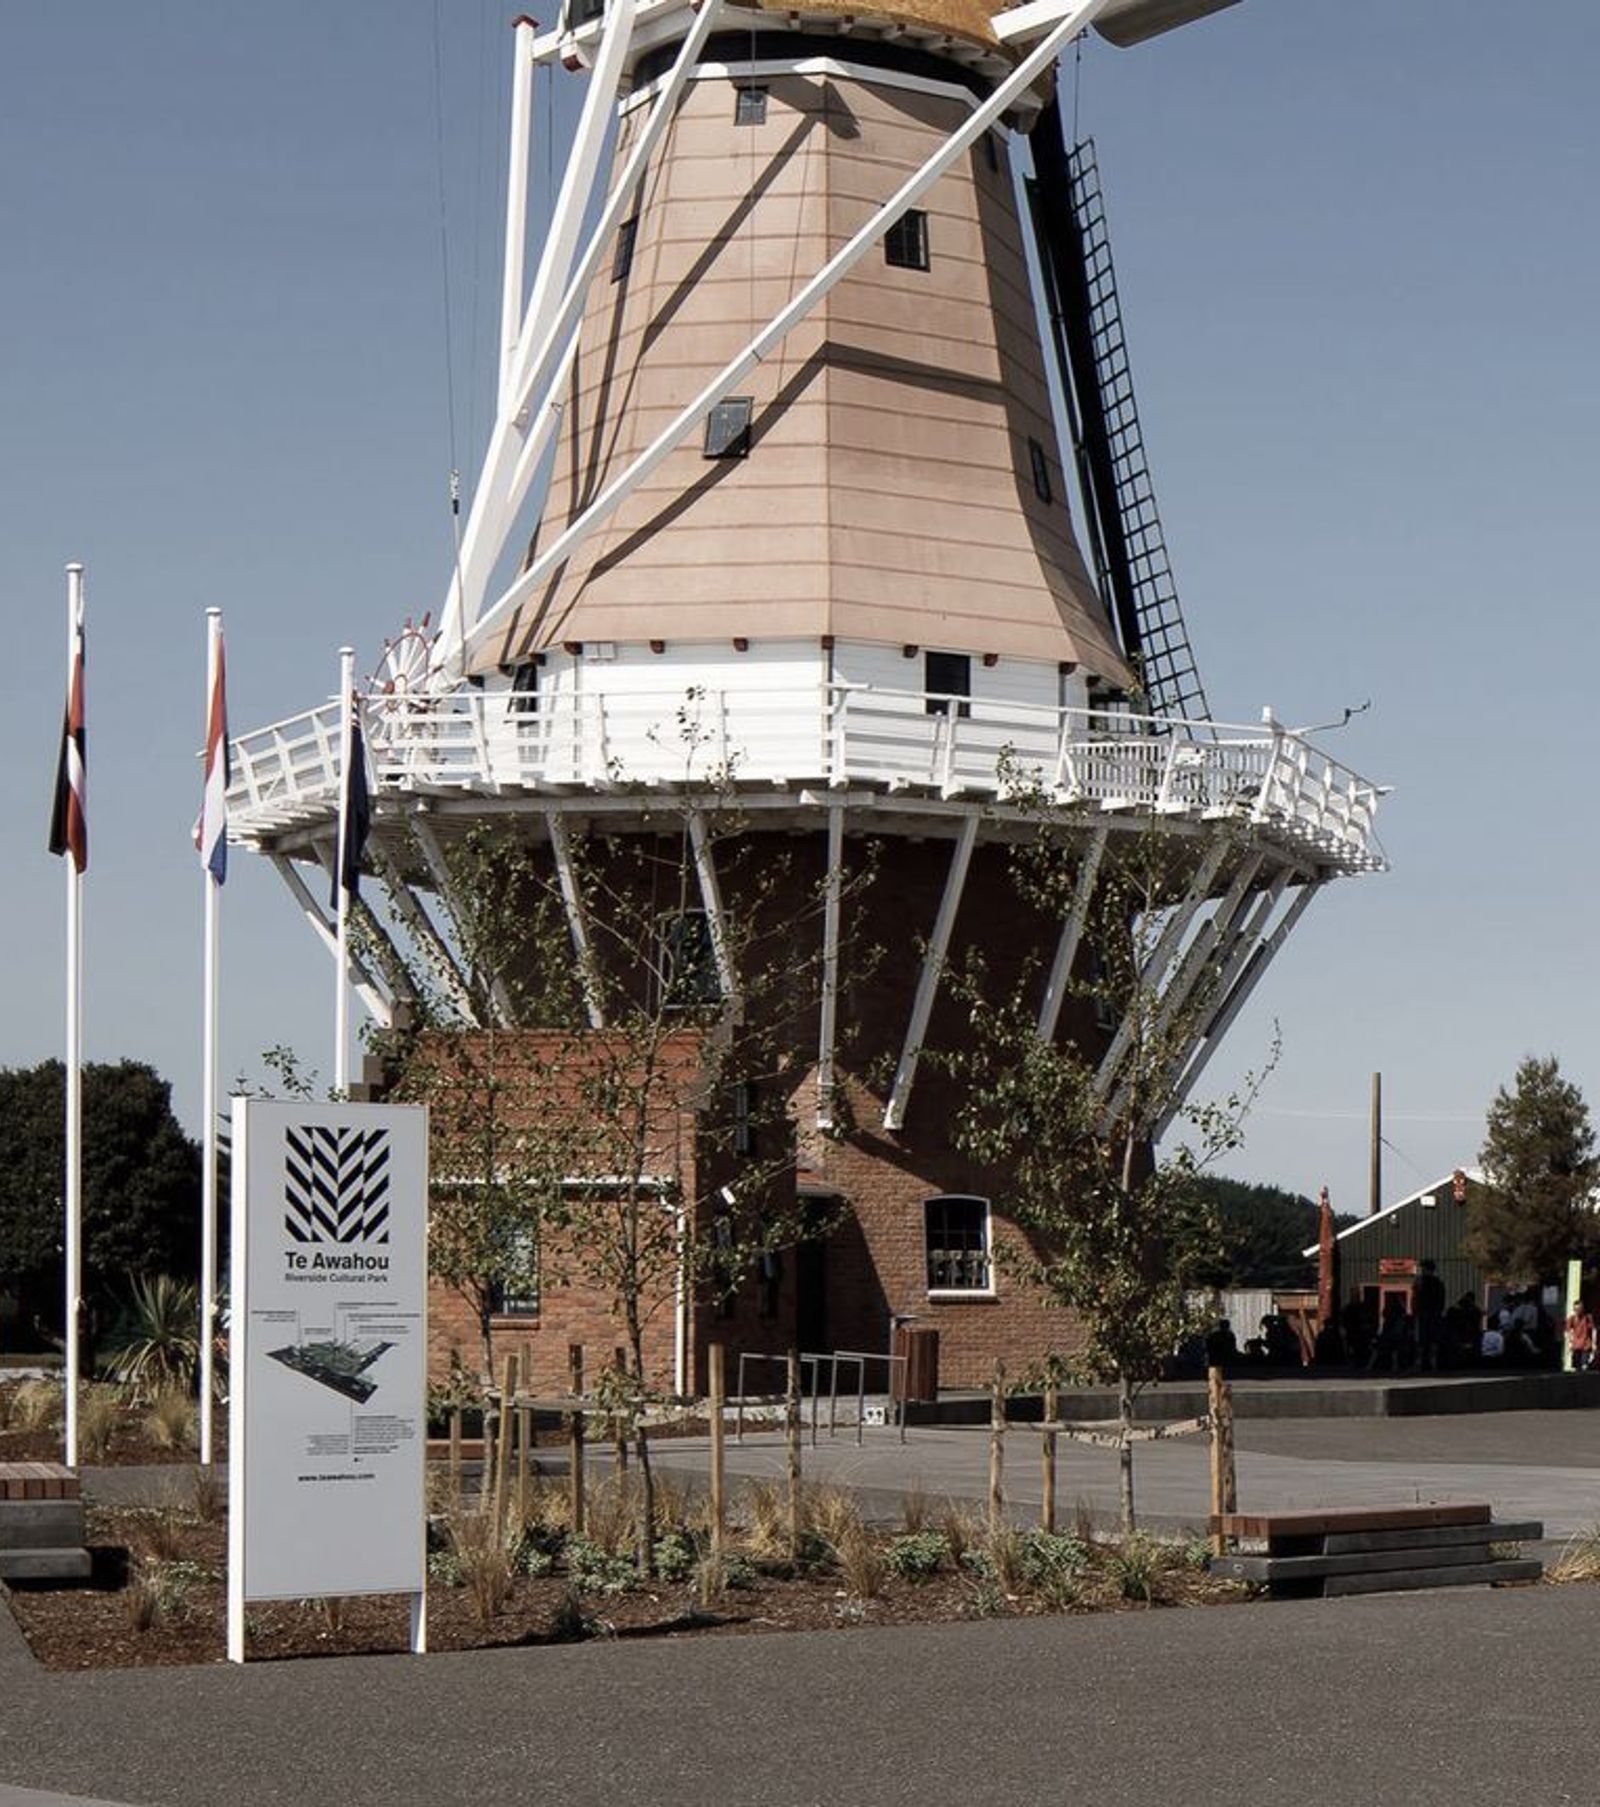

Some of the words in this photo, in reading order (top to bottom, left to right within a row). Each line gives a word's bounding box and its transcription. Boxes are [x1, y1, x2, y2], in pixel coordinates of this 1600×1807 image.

[285, 1252, 307, 1269] Te
[312, 1252, 389, 1270] Awahou
[285, 1273, 327, 1282] Riverside
[329, 1273, 366, 1282] Cultural
[367, 1273, 388, 1282] Park
